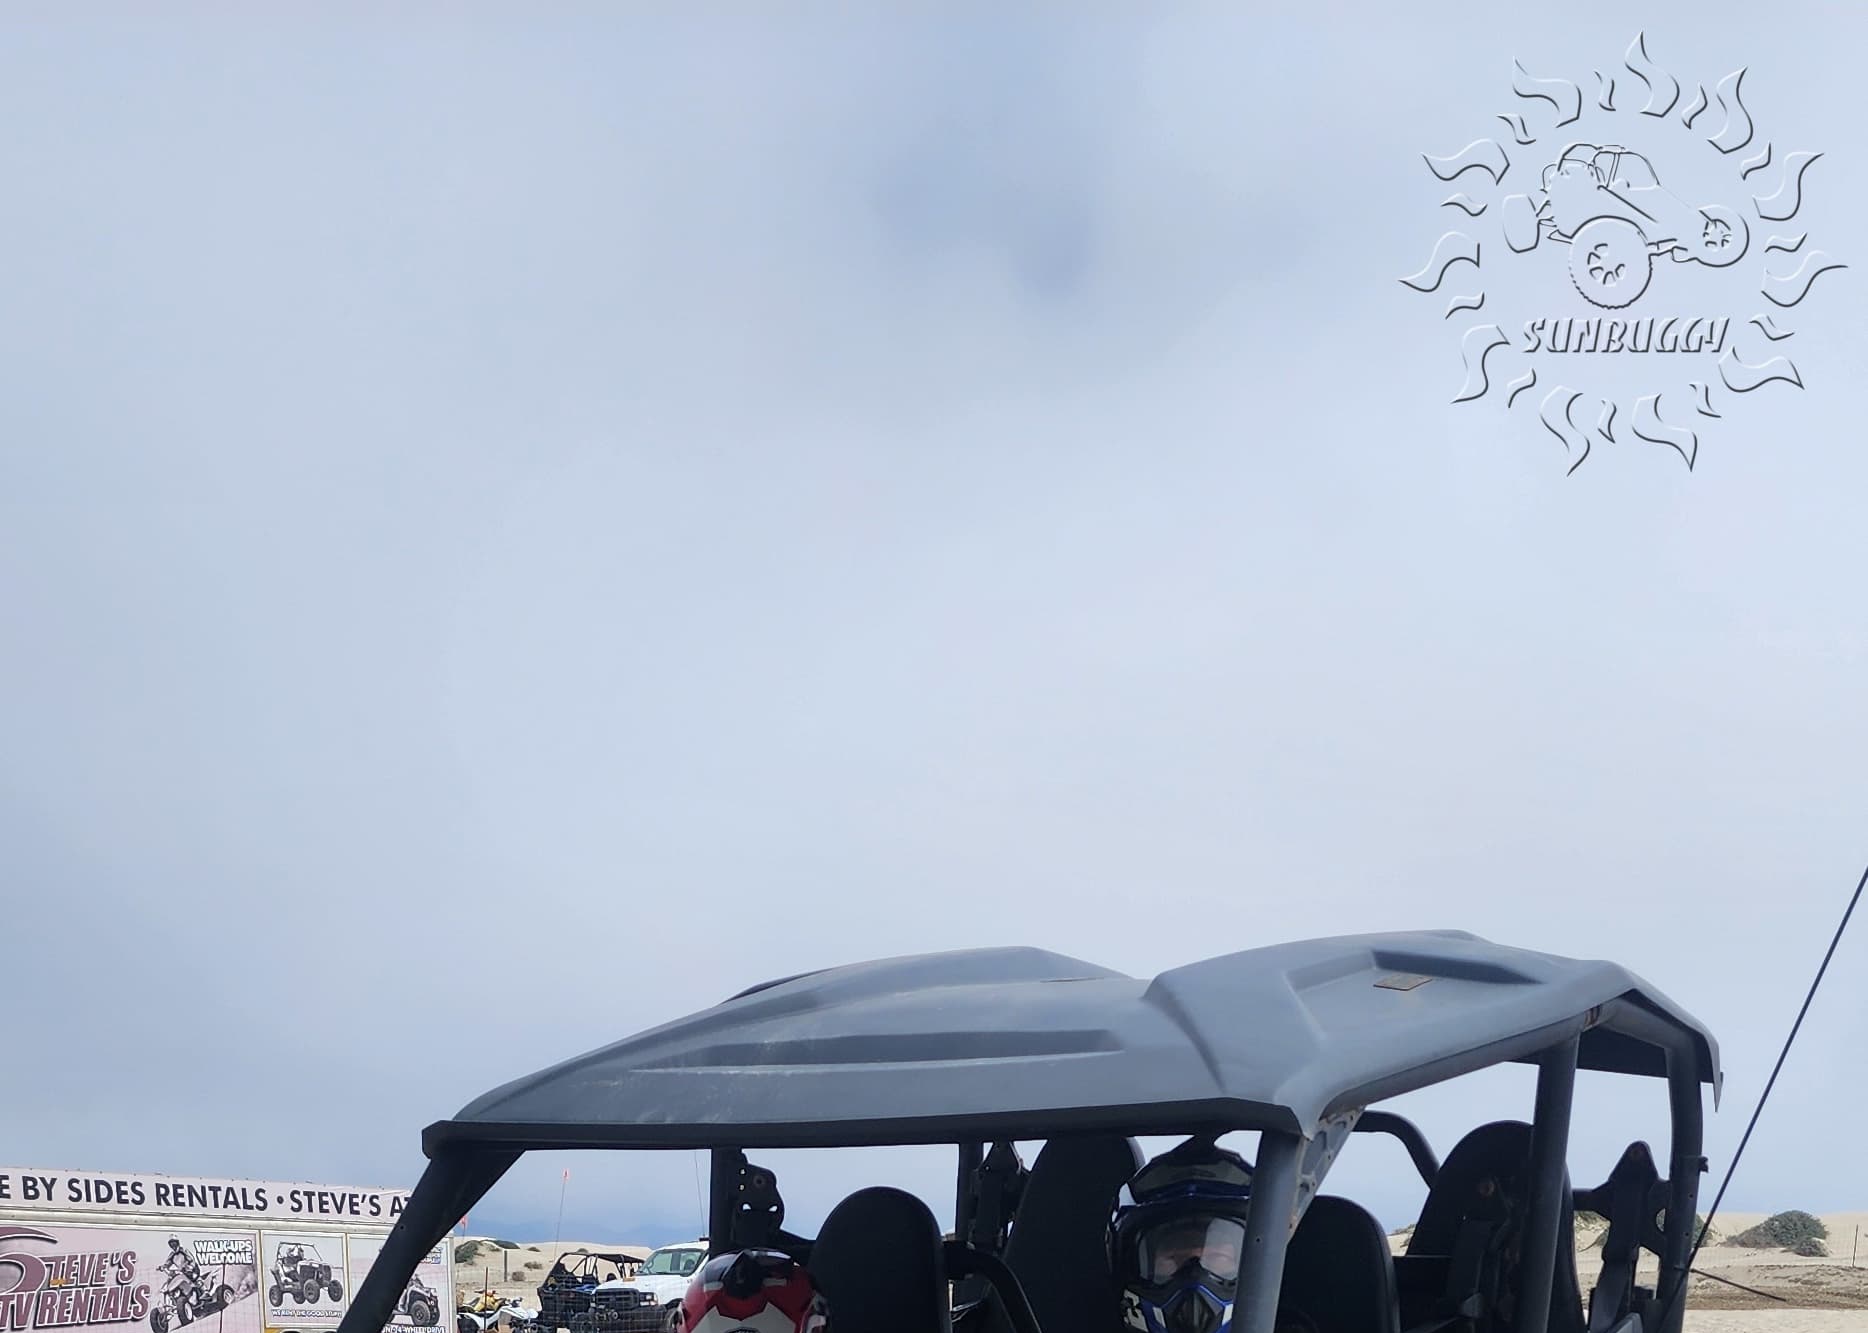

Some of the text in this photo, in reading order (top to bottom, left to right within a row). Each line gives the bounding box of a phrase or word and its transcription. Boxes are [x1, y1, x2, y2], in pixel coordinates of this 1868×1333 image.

[22, 1175, 57, 1202] BY
[67, 1177, 146, 1206] SIDES
[155, 1182, 268, 1212] RENTALS
[290, 1189, 382, 1217] STEVE'S
[193, 1239, 253, 1253] WALK-UPS
[196, 1252, 253, 1266] WELCOME
[34, 1284, 151, 1328] RENTALS
